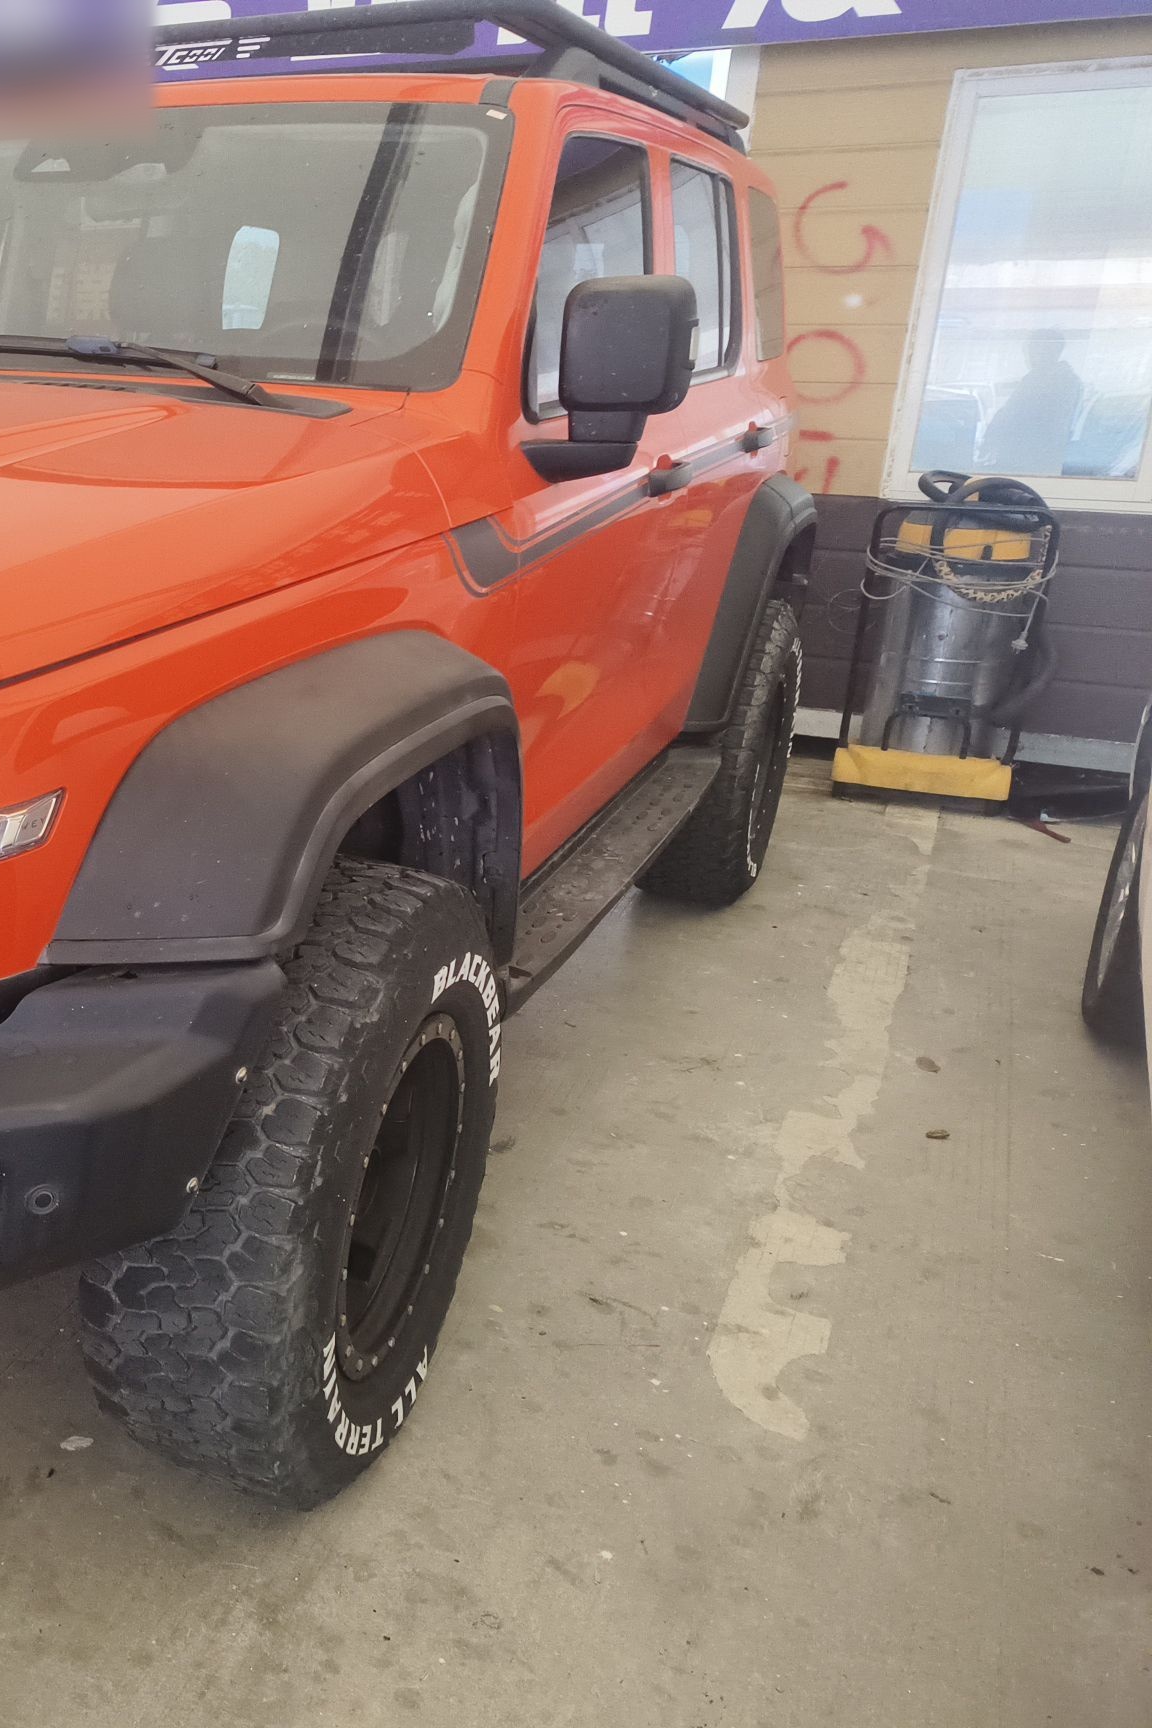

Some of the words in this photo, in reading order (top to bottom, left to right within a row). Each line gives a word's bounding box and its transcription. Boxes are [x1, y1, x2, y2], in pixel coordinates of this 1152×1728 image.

[431, 952, 501, 1087] BLACKBEAR
[323, 1331, 384, 1456] TERRAIN
[391, 1345, 428, 1429] ALL
